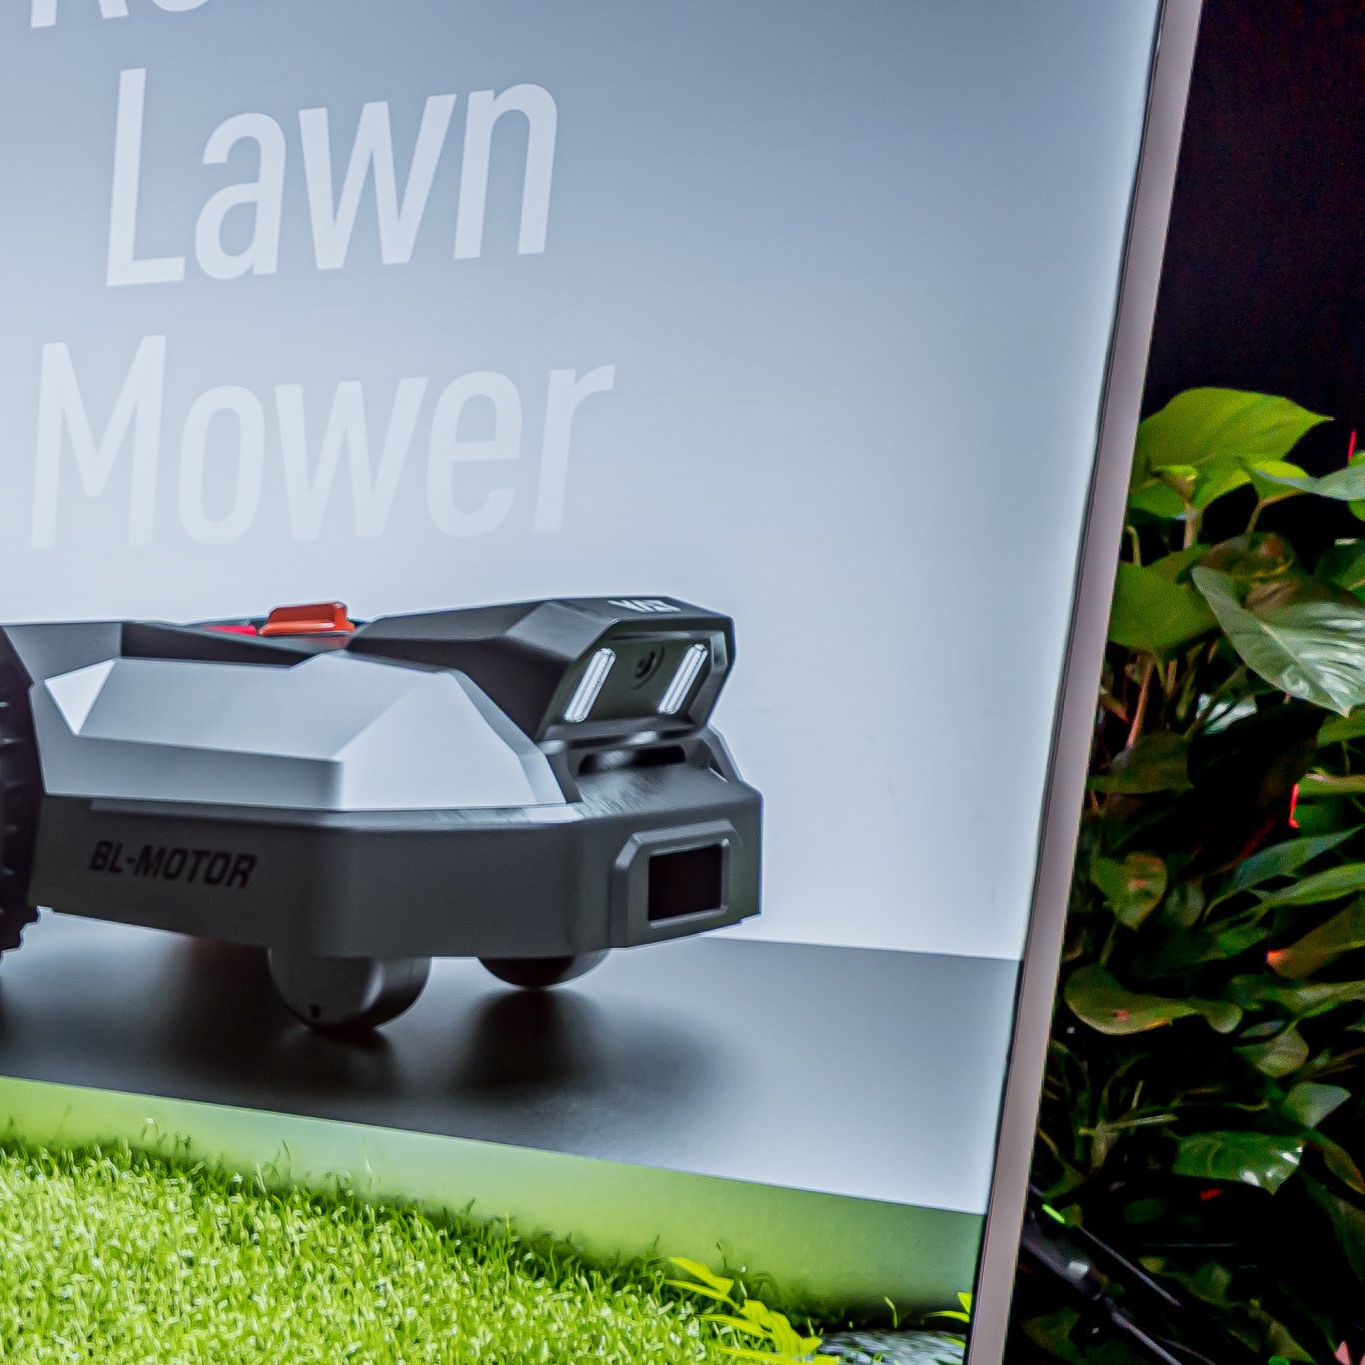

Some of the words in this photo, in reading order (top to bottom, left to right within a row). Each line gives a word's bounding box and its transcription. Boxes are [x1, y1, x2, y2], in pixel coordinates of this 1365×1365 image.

[106, 67, 558, 287] Lawn
[30, 335, 616, 550] Mower
[88, 840, 259, 889] BL-MOTOR
